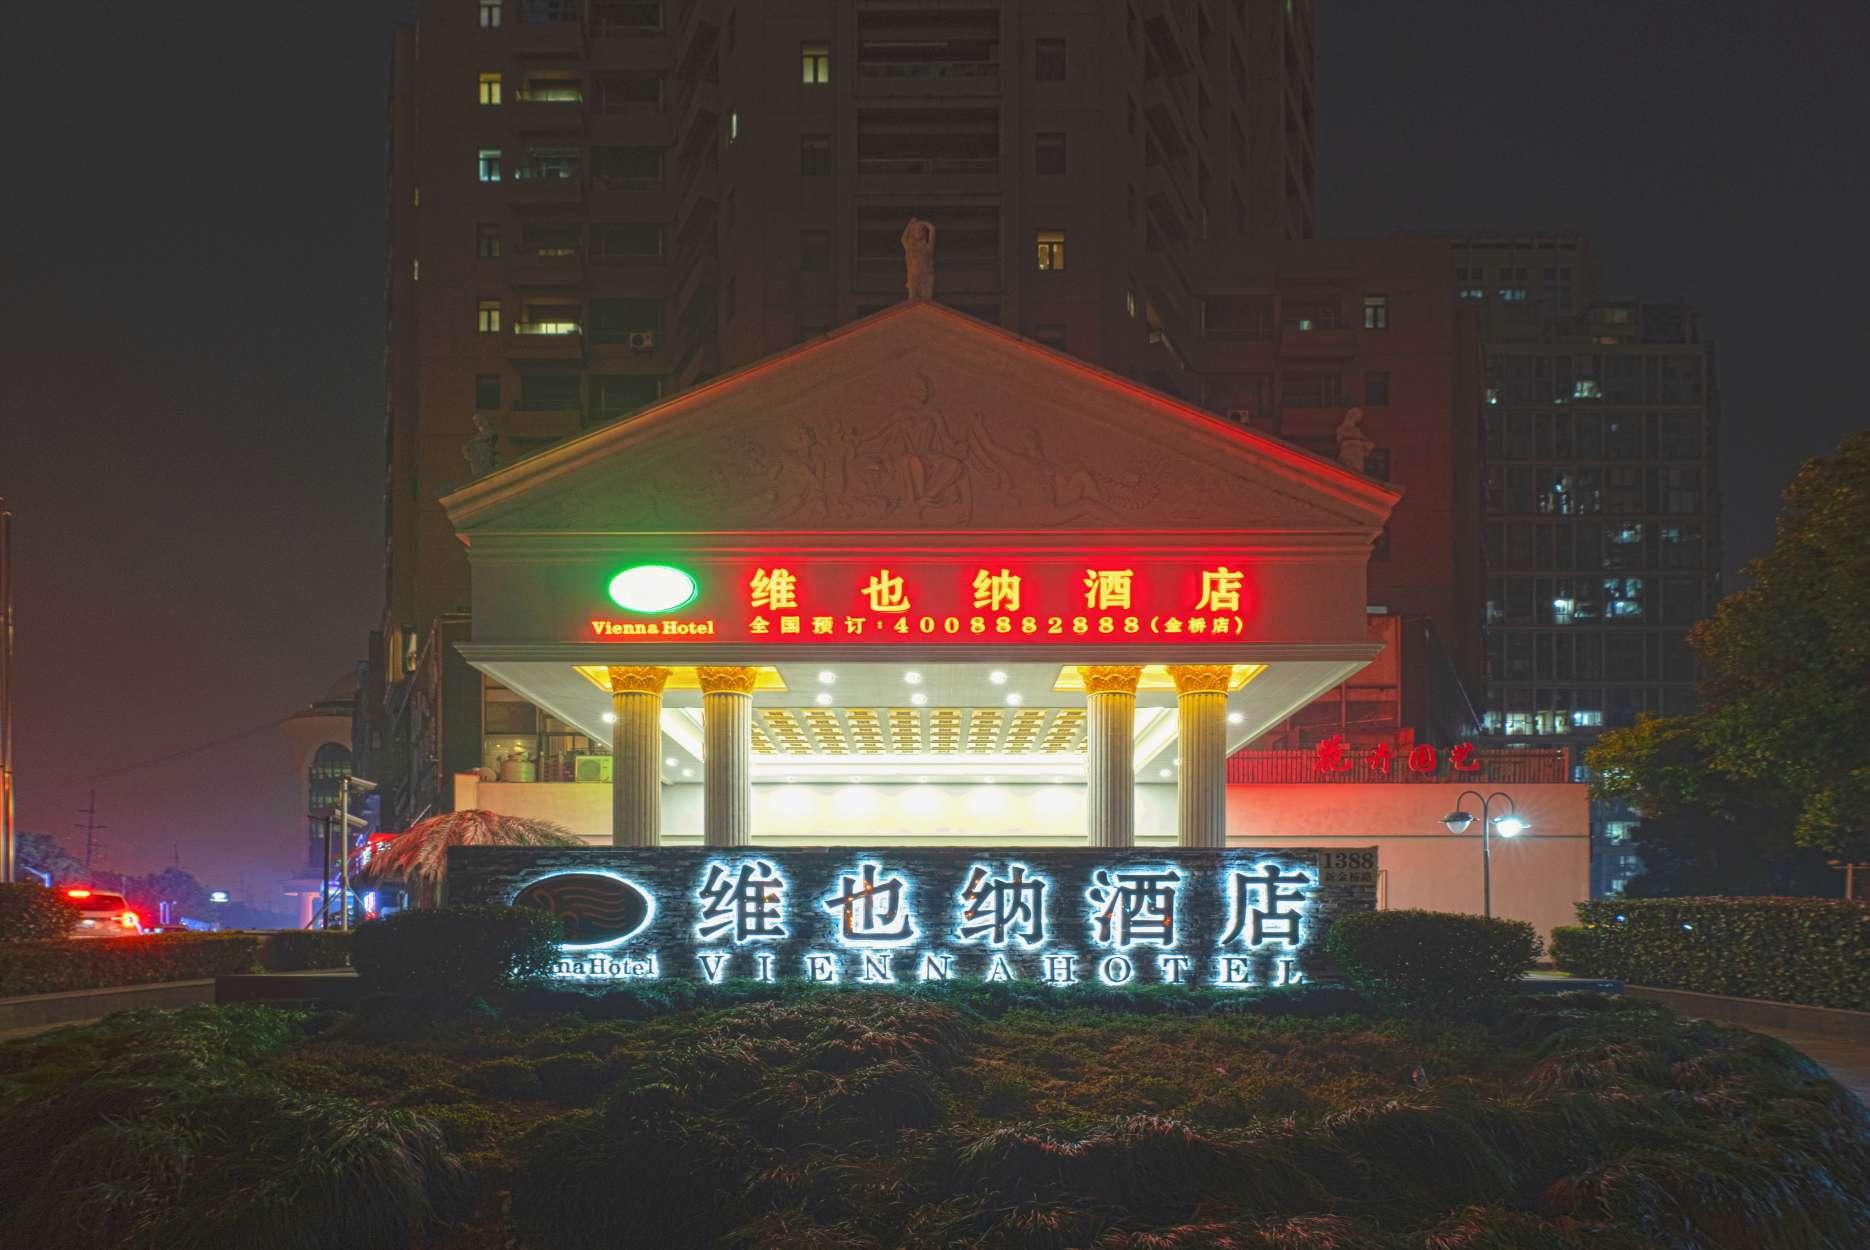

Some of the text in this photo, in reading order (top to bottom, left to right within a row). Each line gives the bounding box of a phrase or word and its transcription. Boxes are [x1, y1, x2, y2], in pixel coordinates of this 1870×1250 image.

[749, 566, 1245, 614] 维也纳酒店
[591, 620, 715, 635] Vienna Hotel
[1323, 852, 1374, 869] 1388
[699, 859, 1311, 947] 维也纳酒店
[589, 957, 656, 976] Hotel
